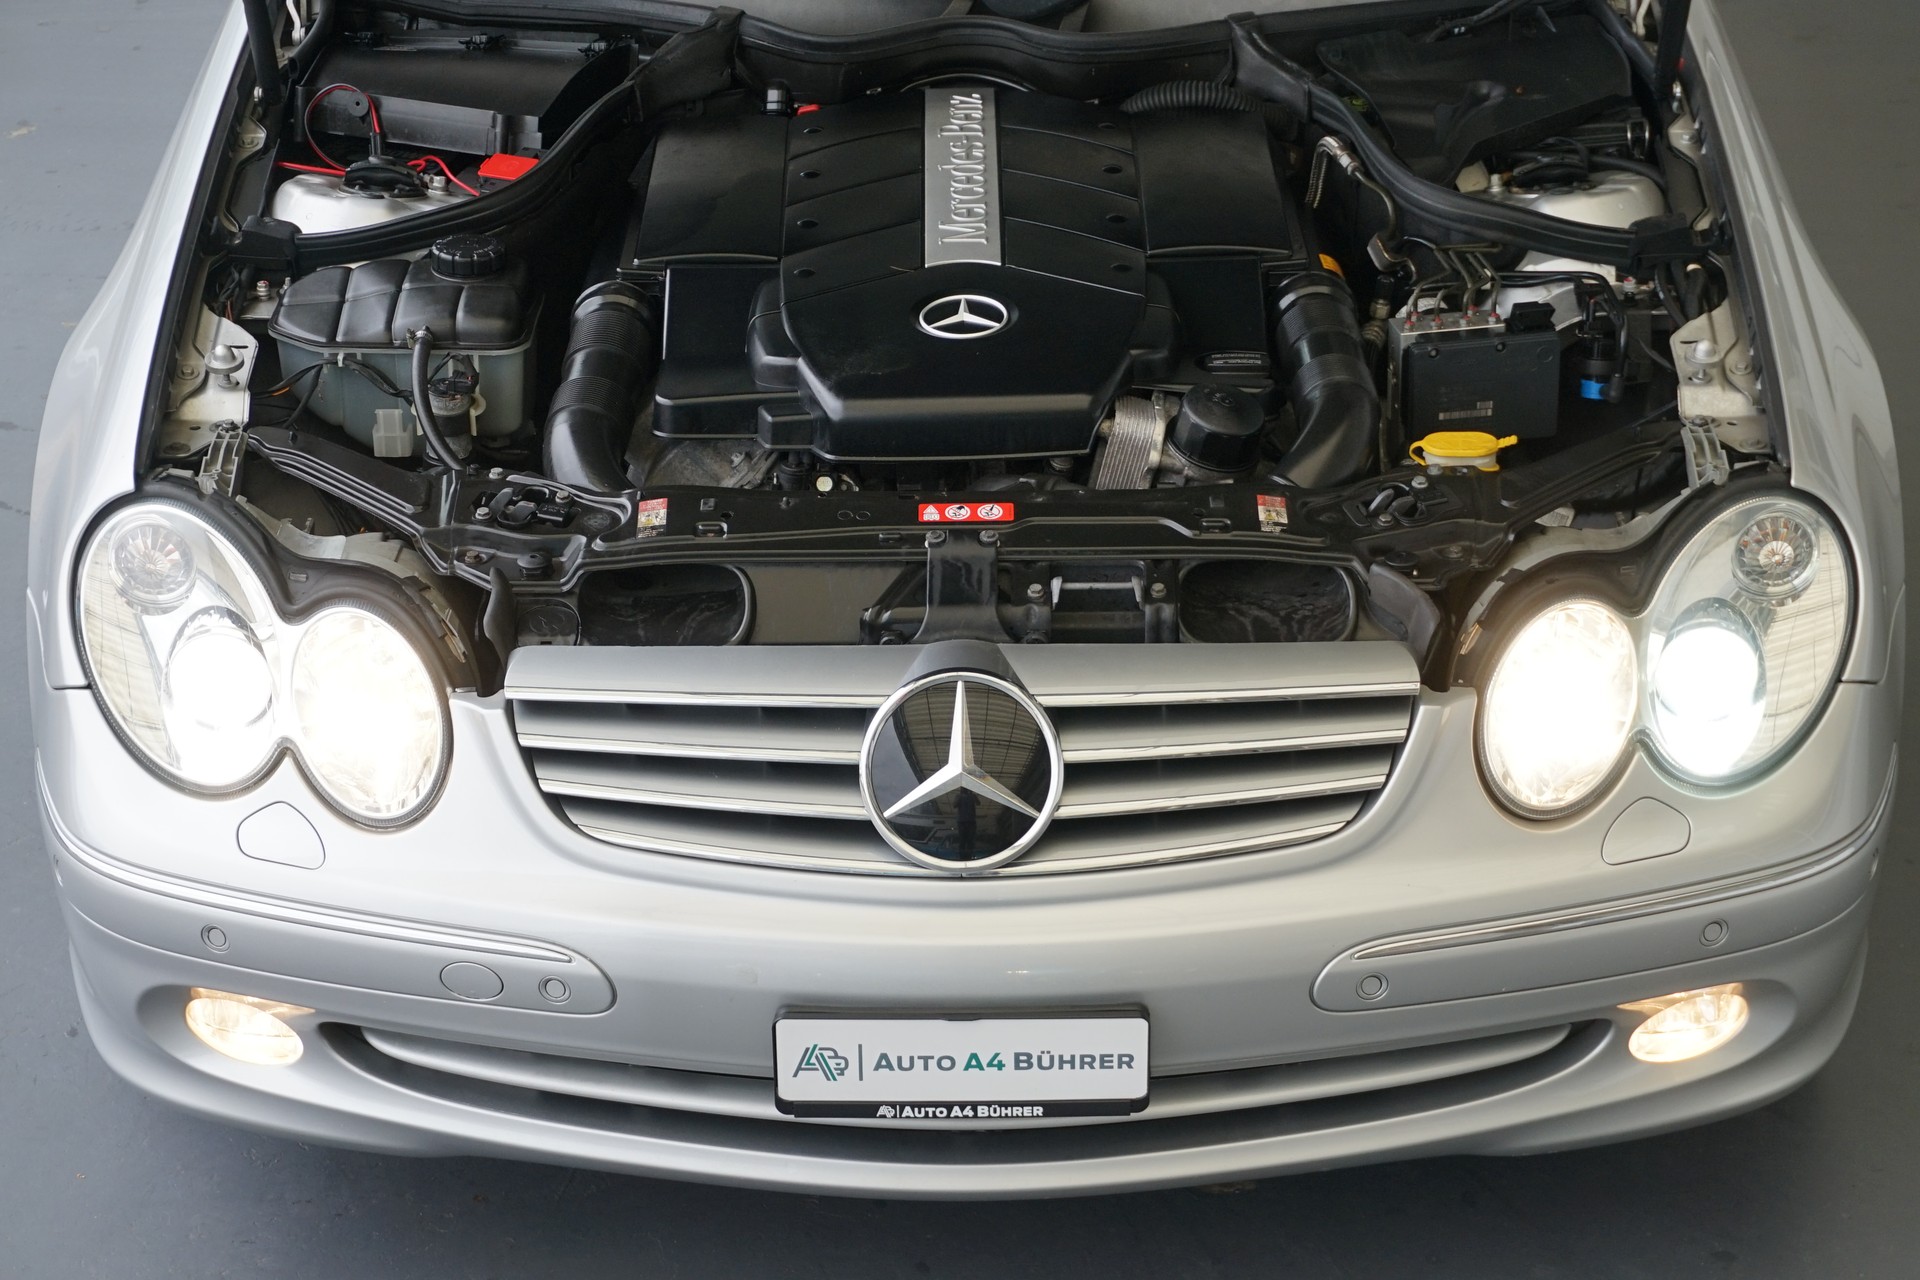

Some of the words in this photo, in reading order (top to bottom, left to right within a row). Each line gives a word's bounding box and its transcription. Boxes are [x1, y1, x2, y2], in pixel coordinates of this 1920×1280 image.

[937, 93, 988, 245] Mercedes-Benz
[872, 1052, 957, 1072] AUTO
[963, 1052, 1006, 1072] A4
[1013, 1050, 1135, 1071] BÜHRER
[901, 1105, 948, 1118] AUTO
[949, 1105, 975, 1118] A4
[977, 1104, 1044, 1118] BÜHRER
